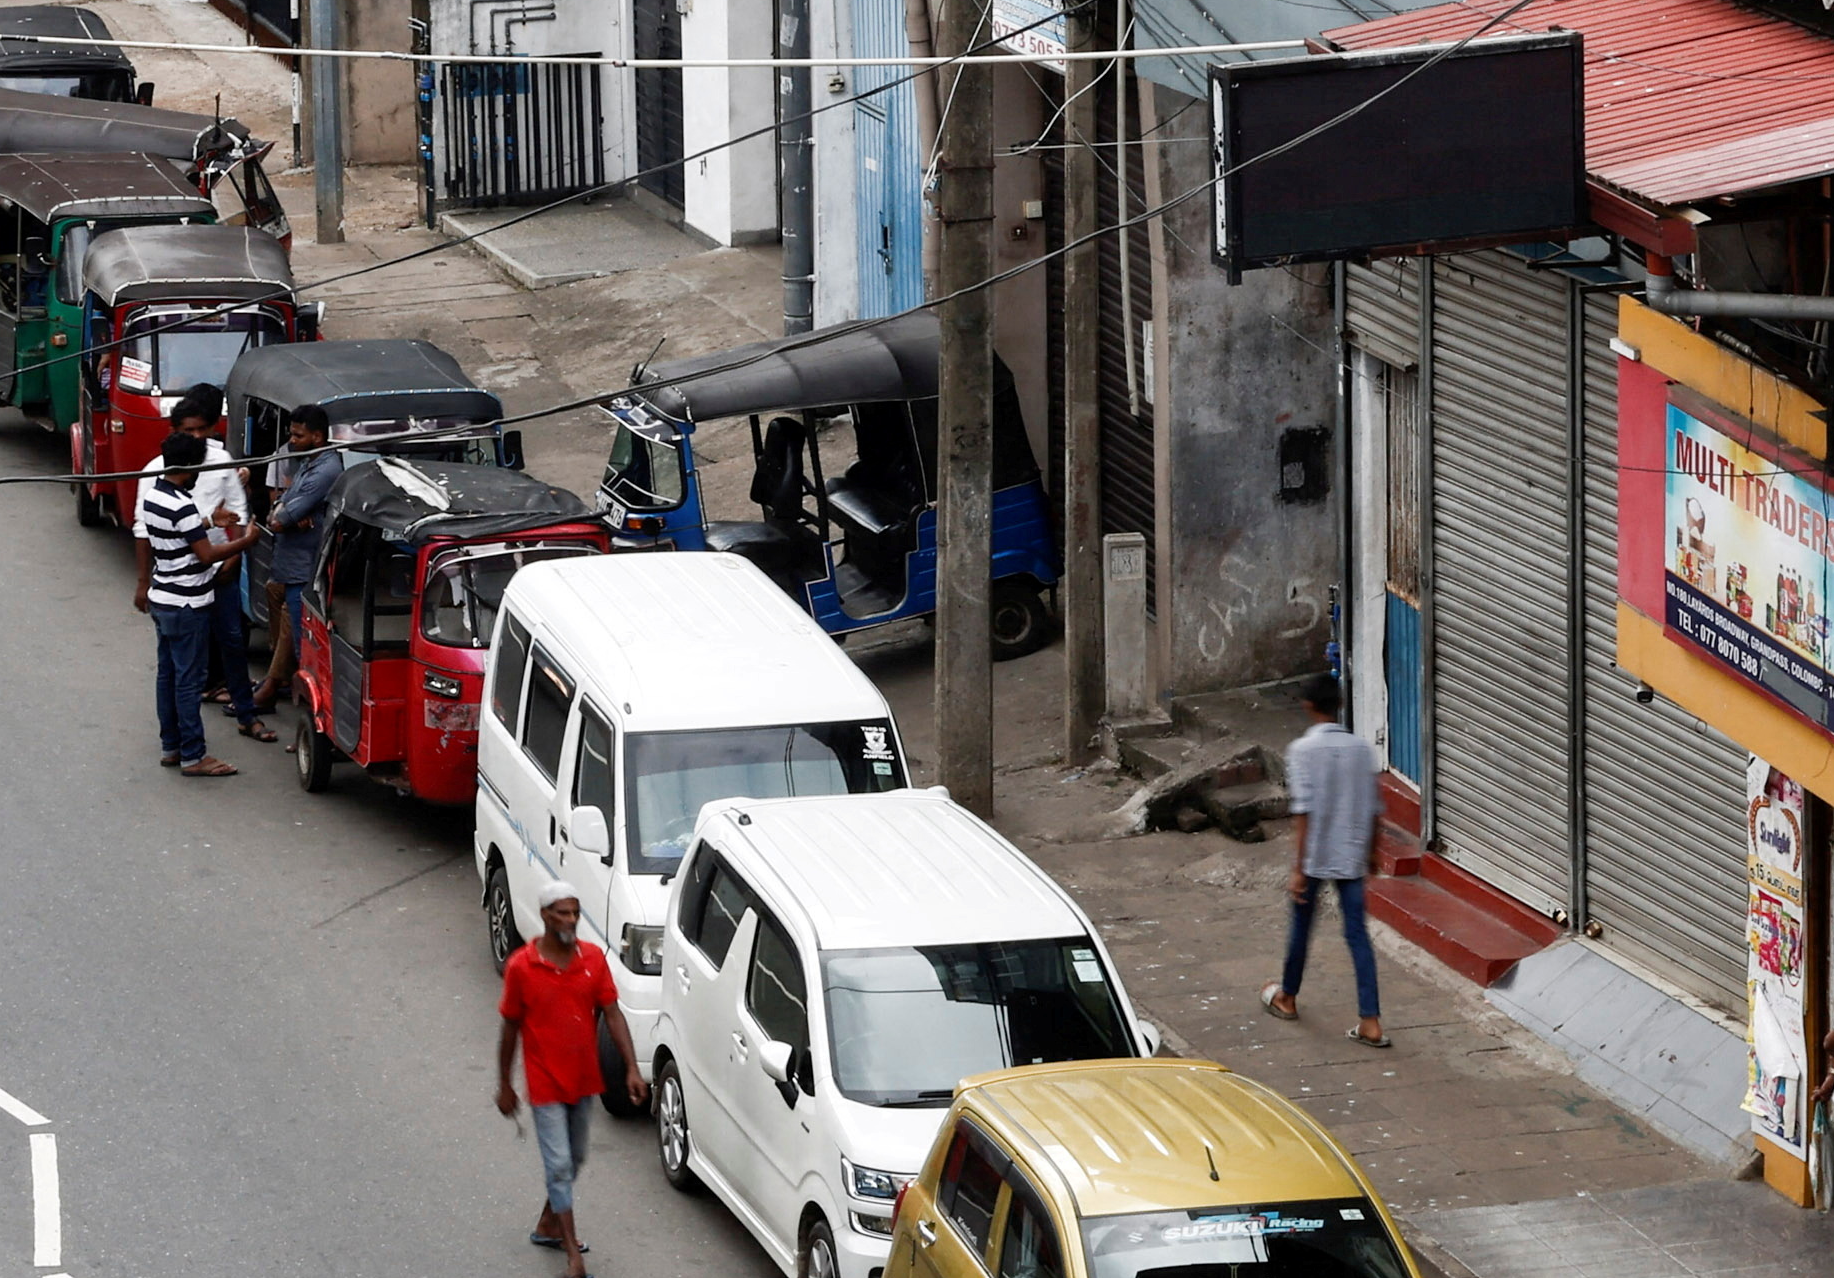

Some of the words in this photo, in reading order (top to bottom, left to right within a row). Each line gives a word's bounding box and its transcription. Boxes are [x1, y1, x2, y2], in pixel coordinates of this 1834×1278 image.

[1675, 429, 1735, 502] MULTI
[1700, 624, 1717, 649] 077
[1718, 636, 1740, 665] 8070
[1741, 651, 1758, 677] 588
[1163, 1219, 1263, 1241] SUZUKI
[1268, 1218, 1325, 1230] Racing
